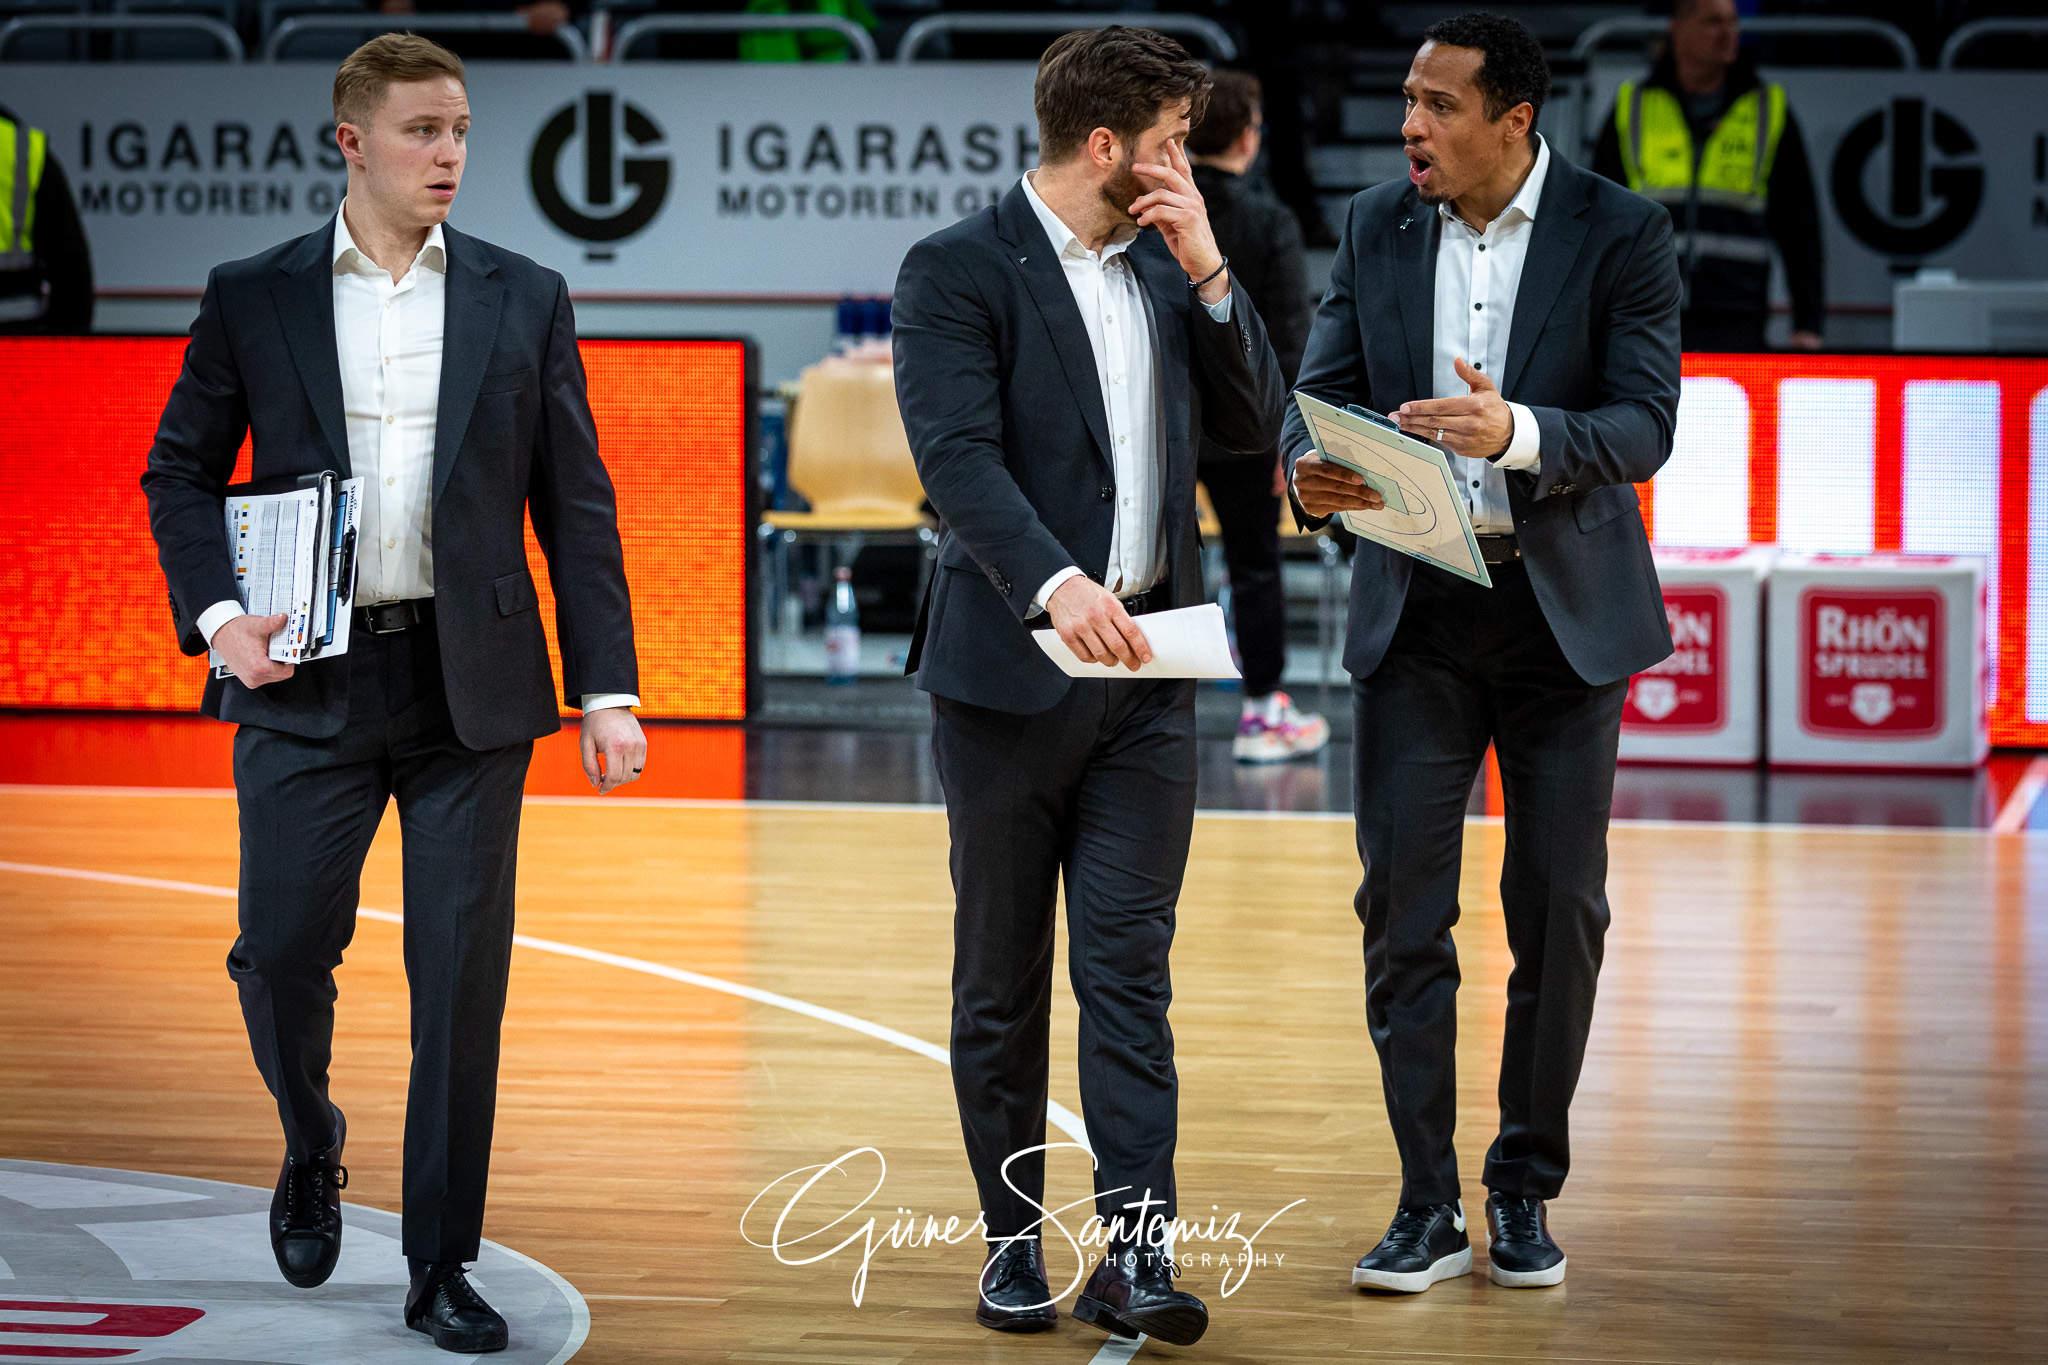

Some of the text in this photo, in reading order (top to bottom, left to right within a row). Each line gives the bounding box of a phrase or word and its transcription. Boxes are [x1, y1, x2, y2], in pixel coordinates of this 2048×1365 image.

[80, 182, 348, 215] MOTOREN G
[719, 185, 1003, 218] MOTOREN G
[1816, 604, 1928, 649] RHÖN
[1646, 651, 1713, 676] UDEL
[1815, 652, 1928, 680] SPRUDEL
